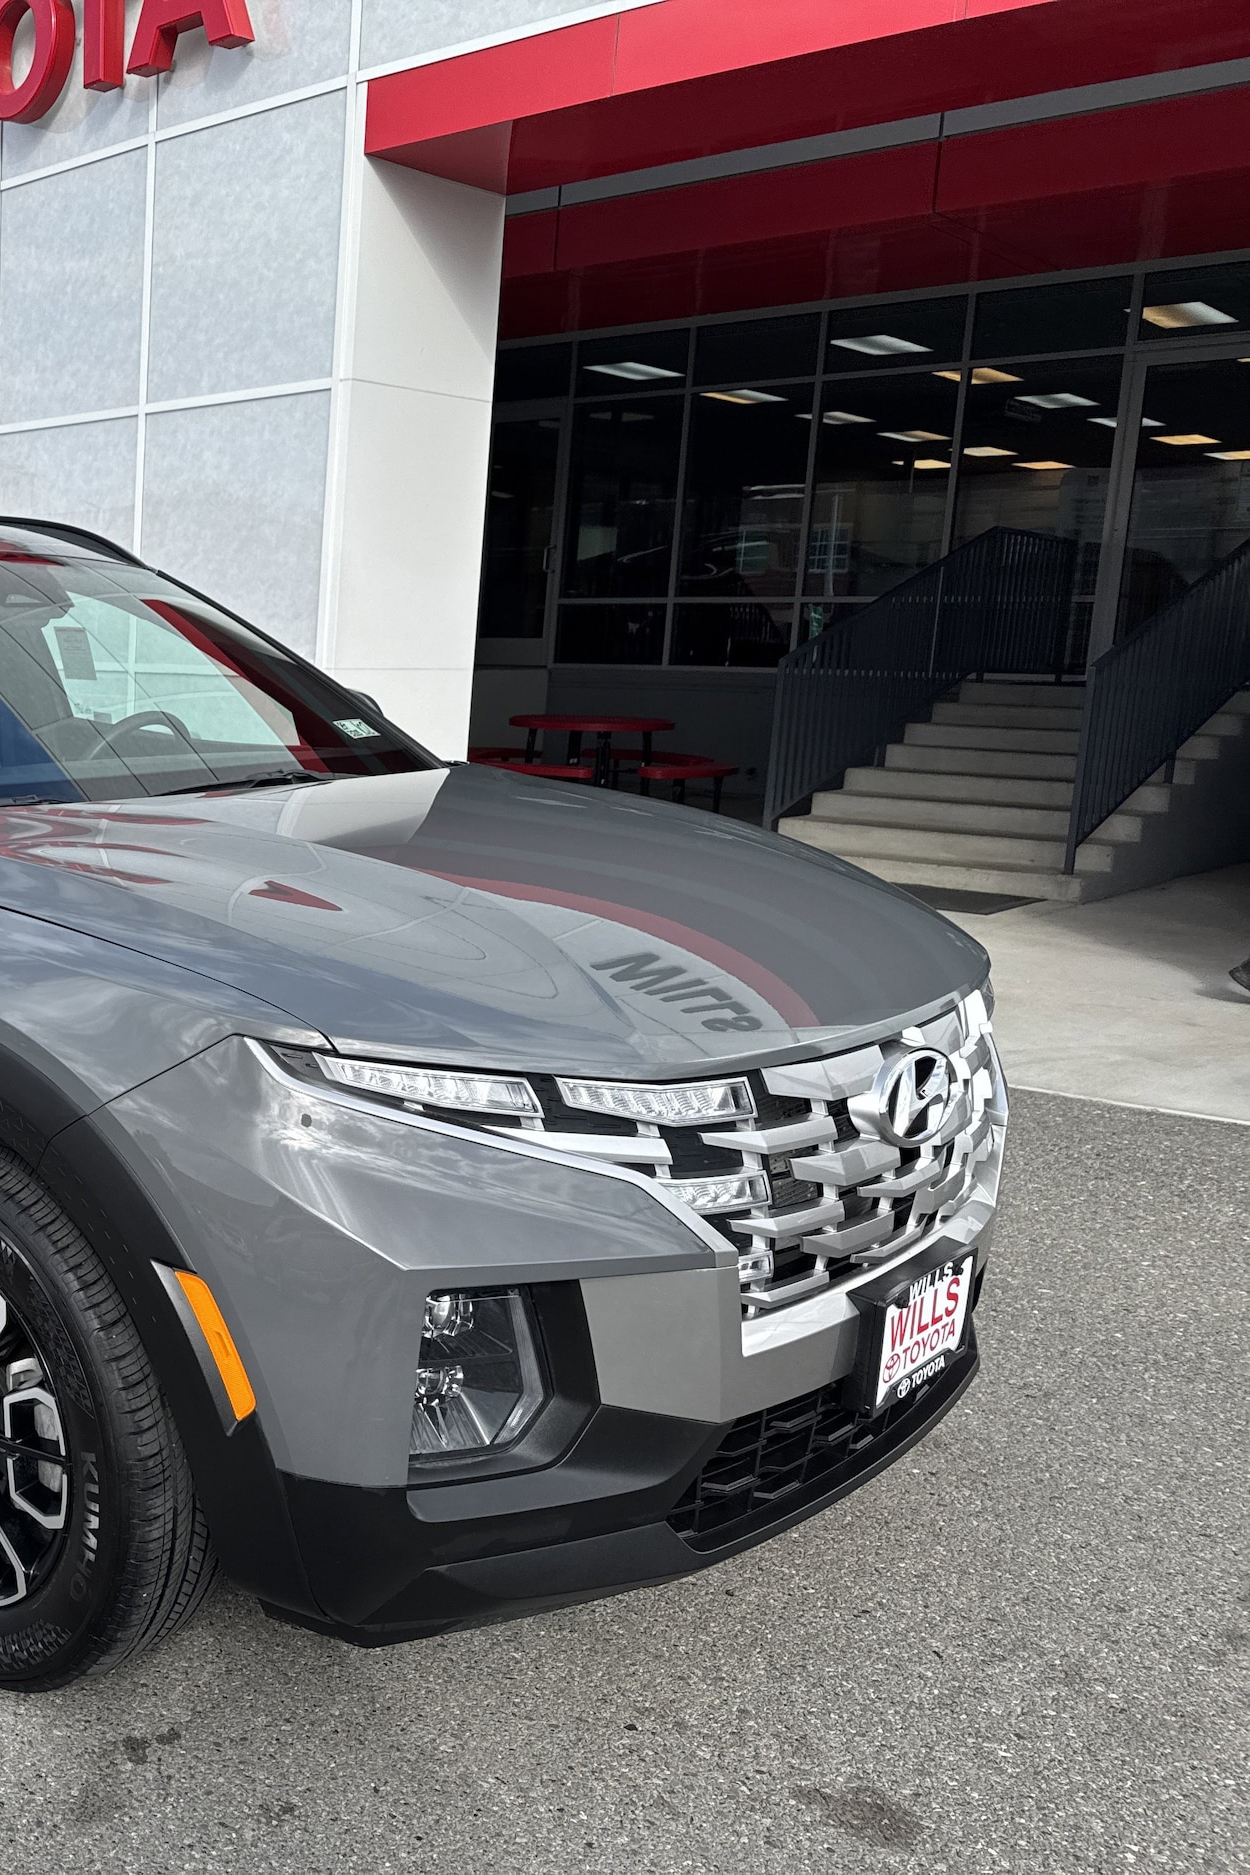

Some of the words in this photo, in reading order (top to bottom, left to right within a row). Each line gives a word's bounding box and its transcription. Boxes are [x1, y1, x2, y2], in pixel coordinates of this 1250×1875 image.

[909, 1261, 954, 1302] WILLS
[890, 1275, 961, 1352] WILLS
[901, 1318, 956, 1370] TOYOTA
[911, 1355, 946, 1388] TOYOTA
[69, 1450, 101, 1603] KUMHO
